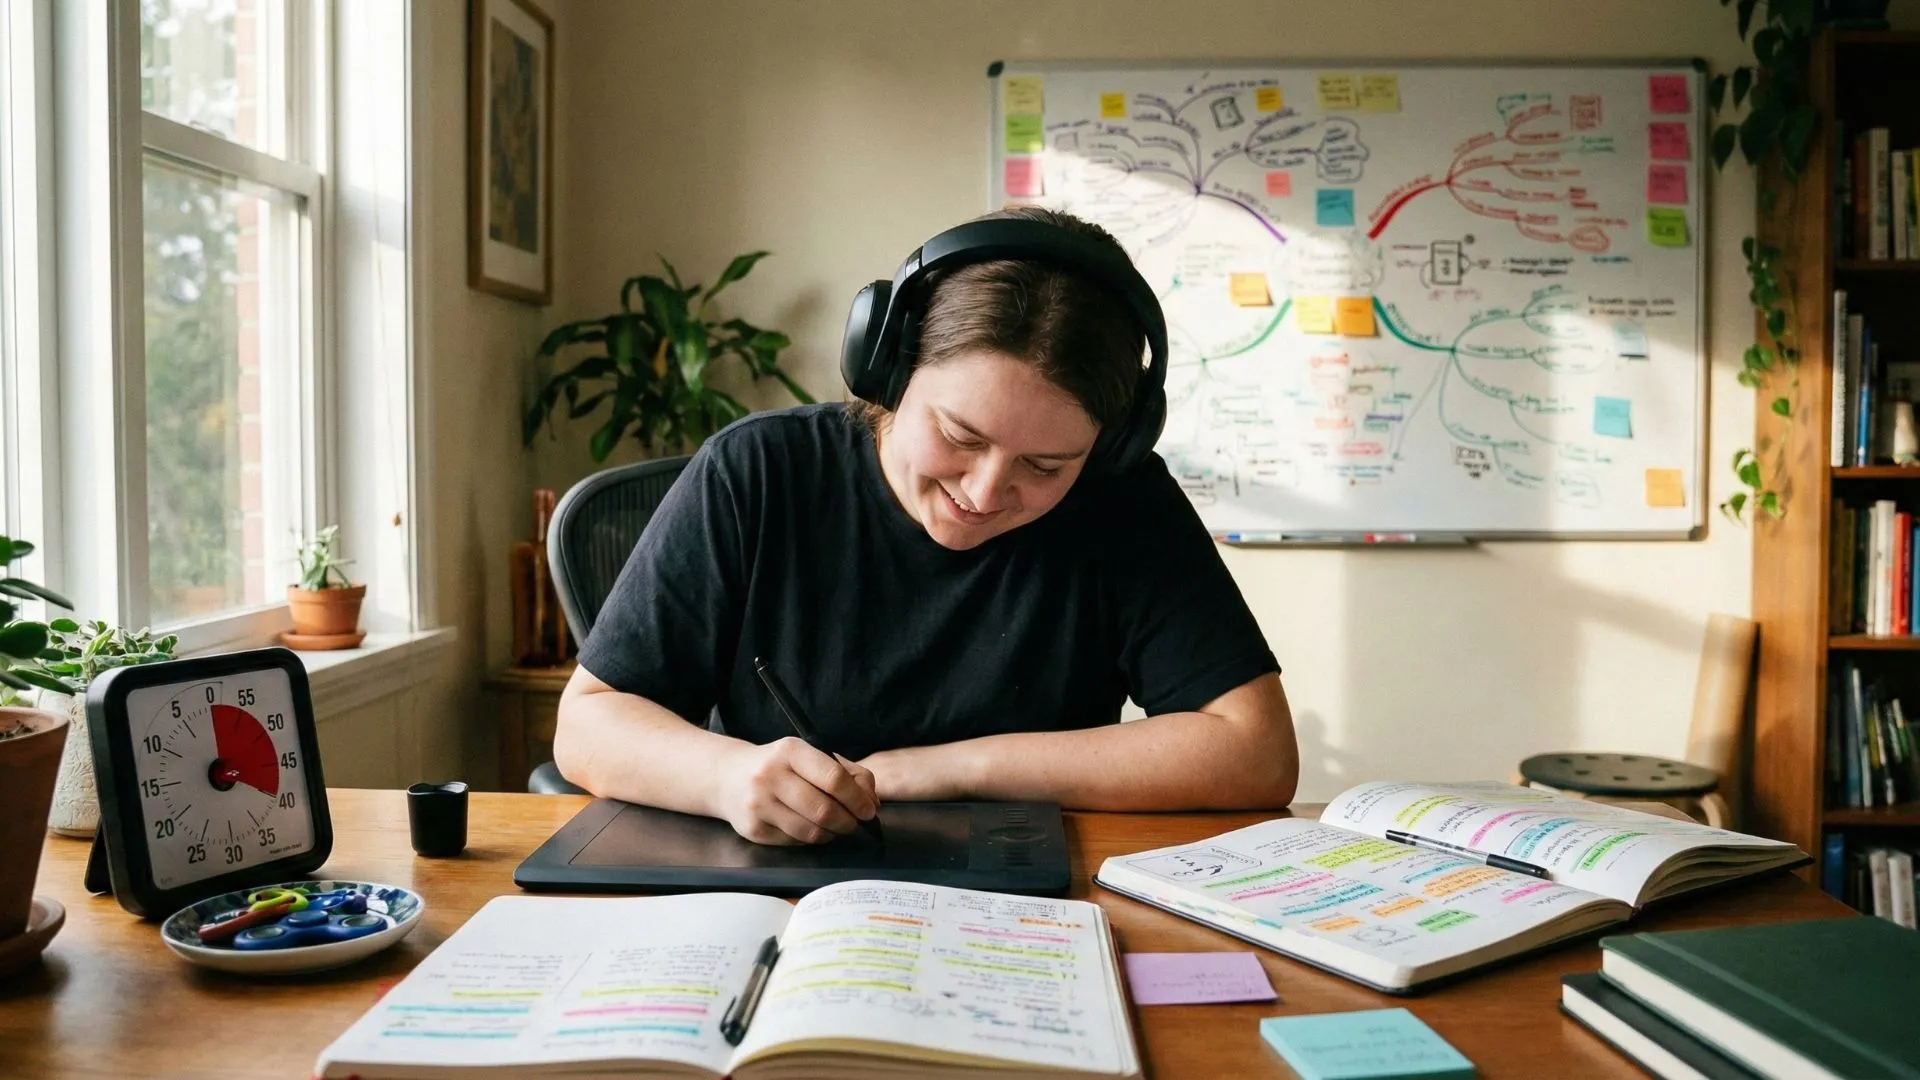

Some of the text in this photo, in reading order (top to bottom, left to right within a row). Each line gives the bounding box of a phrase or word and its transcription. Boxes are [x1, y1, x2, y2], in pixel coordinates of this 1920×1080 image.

[206, 686, 215, 704] 0
[238, 688, 255, 707] 55
[171, 701, 182, 718] 5
[267, 713, 284, 732] 50
[143, 735, 161, 754] 10
[281, 752, 297, 769] 45
[141, 778, 160, 798] 15
[279, 792, 295, 810] 40
[155, 818, 174, 839] 20
[258, 828, 276, 847] 35
[187, 844, 206, 864] 25
[225, 845, 243, 865] 30
